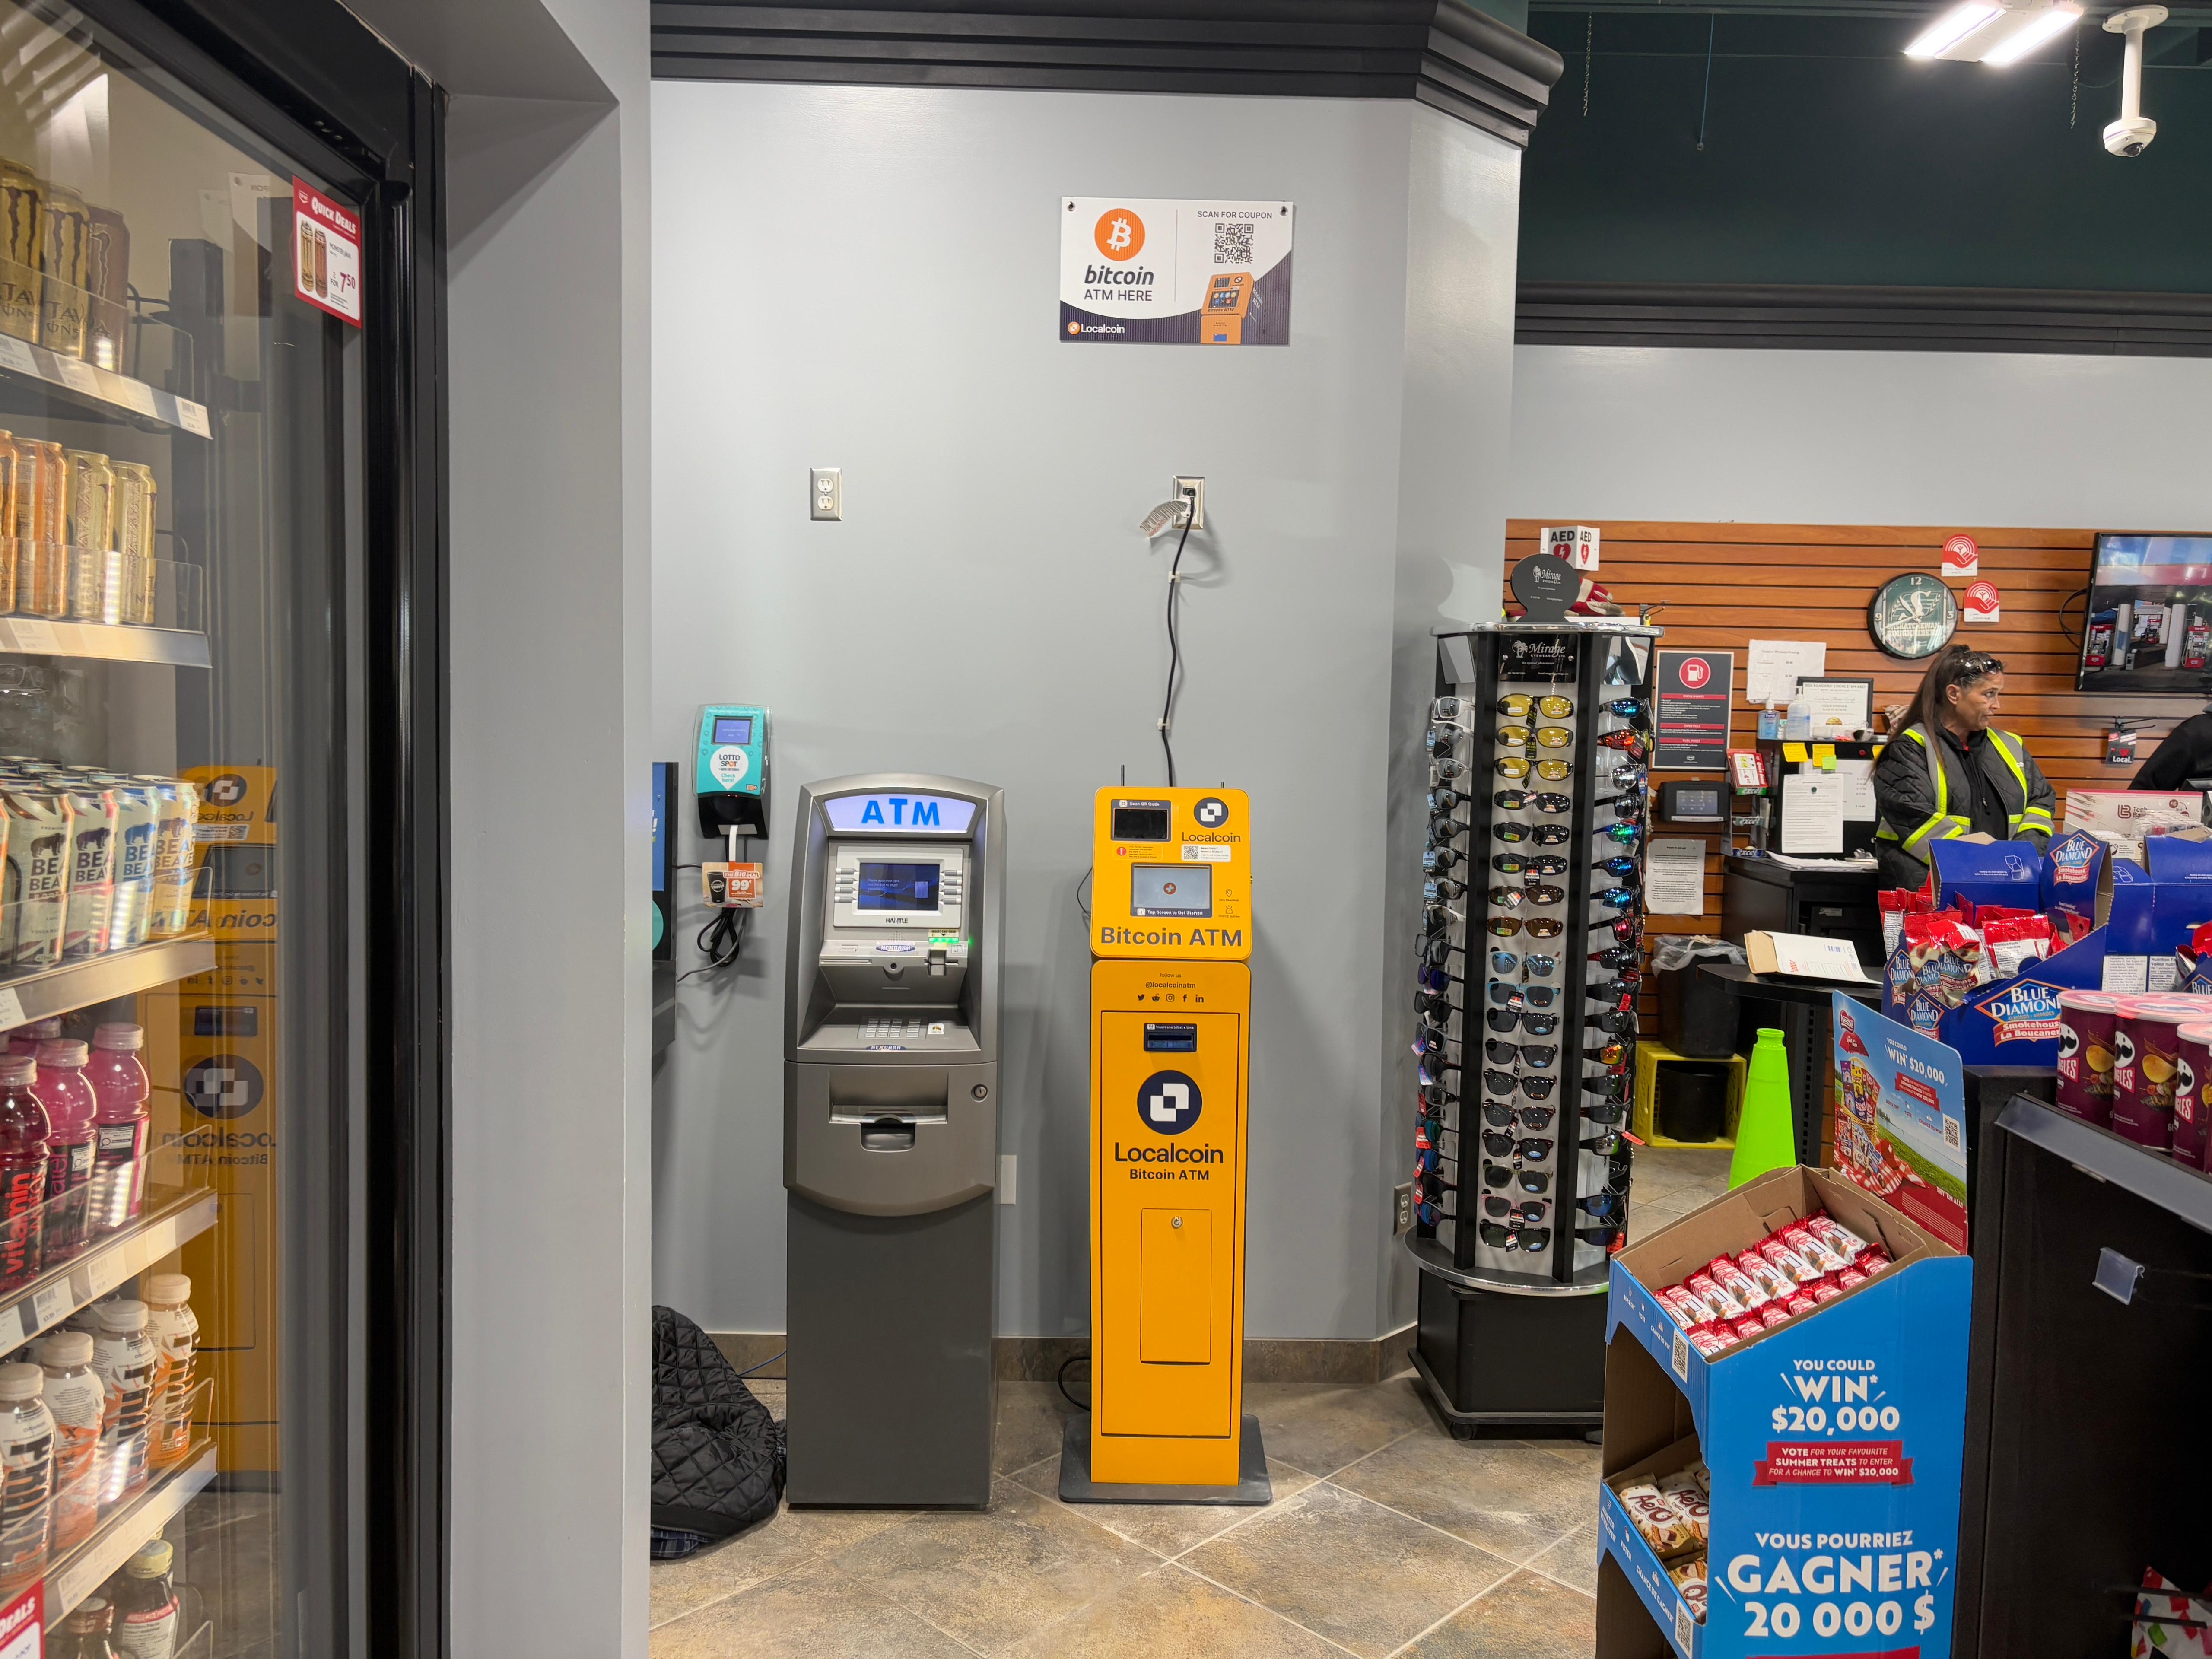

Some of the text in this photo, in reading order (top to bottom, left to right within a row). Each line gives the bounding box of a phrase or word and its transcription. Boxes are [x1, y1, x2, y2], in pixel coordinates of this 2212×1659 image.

[311, 196, 334, 222] QUICK
[335, 210, 357, 235] DEALS
[1084, 264, 1154, 286] bitcoin
[1084, 289, 1153, 302] ATM HERE
[1081, 323, 1125, 334] Localcoin
[1550, 530, 1575, 543] AED
[1580, 530, 1592, 543] AED
[1541, 569, 1561, 584] Mirage
[1910, 577, 1922, 585] 12
[1875, 613, 1883, 621] 9
[1947, 610, 1954, 619] 3
[1528, 642, 1566, 658] Mirage
[861, 798, 941, 826] ATM
[1181, 832, 1241, 843] Localcoin
[2066, 839, 2086, 852] BLUE
[2056, 847, 2093, 862] DIAMOND
[1101, 926, 1242, 947] Bitcoin ATM
[1896, 957, 1910, 969] BLUE
[1945, 953, 1961, 966] BLUE
[1145, 981, 1196, 989] @localcoinatm
[2011, 987, 2050, 1003] BLUE
[1916, 999, 1930, 1012] BLUE
[1991, 995, 2061, 1017] DIAMON
[1910, 1011, 1939, 1022] DIAMOND
[2003, 1021, 2061, 1031] Smokehous
[2014, 1029, 2061, 1037] Boucaner
[1887, 1037, 1907, 1051] YOU COULD
[1909, 1056, 1945, 1084] $20,000
[1115, 1142, 1224, 1163] Localcoin
[1130, 1169, 1209, 1180] Bitcoin ATM
[1936, 1186, 1945, 1198] TRY
[1954, 1195, 1964, 1209] ALL!
[1, 1173, 31, 1274] vitamin
[1793, 1360, 1875, 1371] YOU COULD
[1772, 1404, 1900, 1436] $20,000
[1781, 1448, 1809, 1456] VOTE
[1776, 1459, 1818, 1467] SUMMER
[1820, 1458, 1857, 1467] TREATS
[1792, 1468, 1821, 1476] CHANCE
[1859, 1468, 1899, 1477] $20,000
[1755, 1530, 1913, 1549] VOUS POURRIEZ
[1620, 1538, 1632, 1562] VOTER
[1636, 1564, 1657, 1600] CHANCE DE
[1743, 1589, 1936, 1638] 20 000 $
